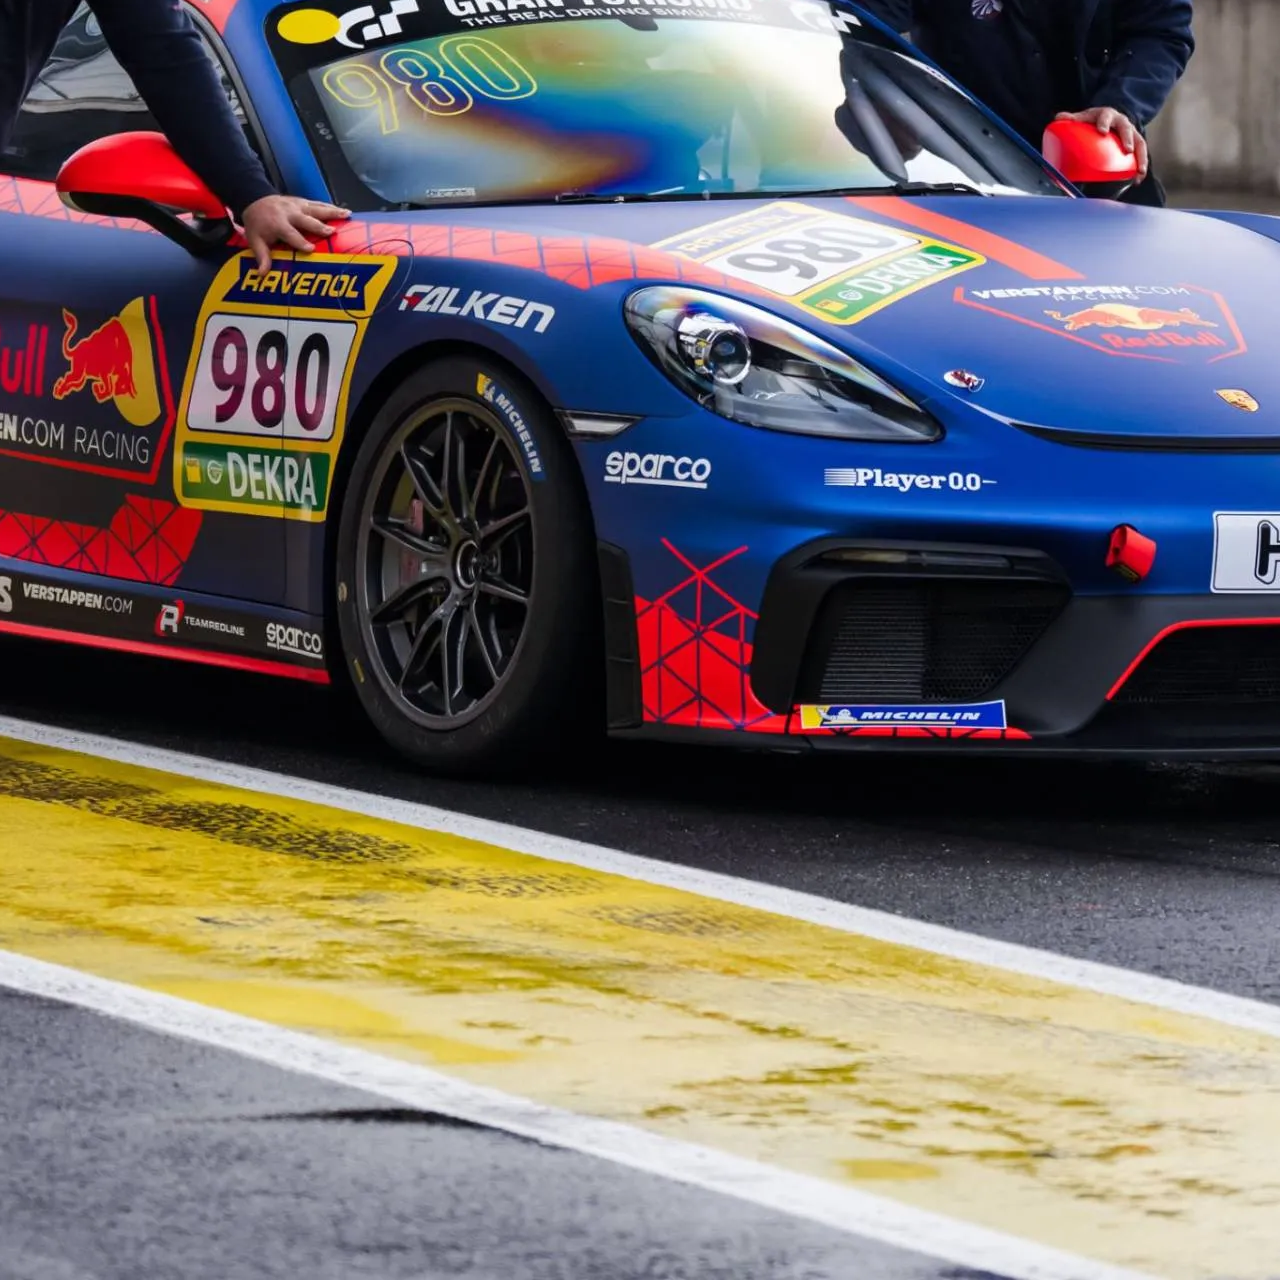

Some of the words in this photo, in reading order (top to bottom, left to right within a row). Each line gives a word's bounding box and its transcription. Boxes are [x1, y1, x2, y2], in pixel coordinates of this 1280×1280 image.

[461, 16, 504, 28] THE
[511, 10, 566, 22] REAL
[567, 6, 649, 18] DRIVING
[323, 36, 537, 135] 980
[726, 226, 898, 280] 980
[240, 269, 361, 298] RAVENOL
[845, 252, 968, 295] DEKRA
[971, 285, 1192, 299] VERSTAPPEN.COM
[399, 284, 556, 334] FALKEN
[211, 326, 330, 432] 980
[74, 426, 150, 465] RACING
[496, 393, 542, 473] MICHELIN
[227, 451, 318, 506] DEKRA
[604, 451, 712, 488] sparco
[855, 468, 947, 493] Player
[23, 582, 133, 614] VERSTAPPEN.COM
[184, 616, 245, 636] TEAMREDLINE
[266, 622, 323, 658] sparco
[860, 711, 981, 721] MICHELIN
